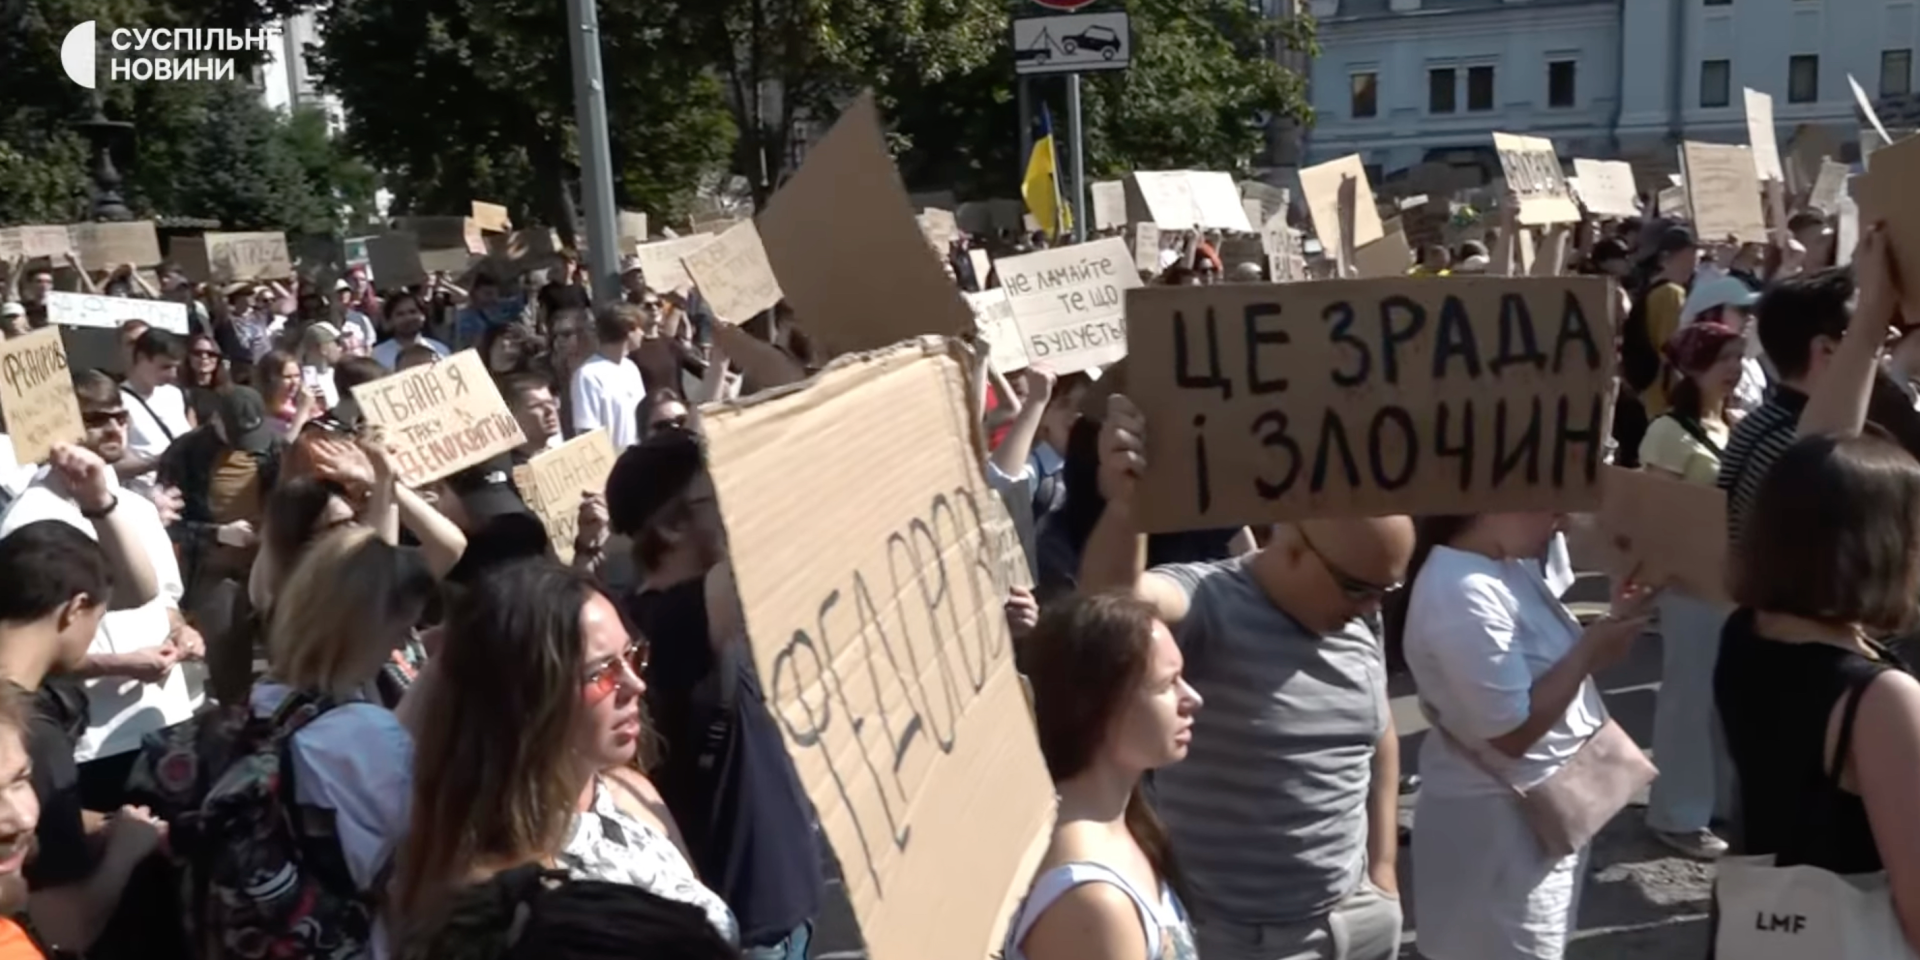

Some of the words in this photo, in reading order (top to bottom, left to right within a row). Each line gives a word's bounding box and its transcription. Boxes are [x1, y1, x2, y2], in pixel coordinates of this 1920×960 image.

[1172, 303, 1292, 399] ЦЕ
[1321, 290, 1601, 388] ЗРАДА
[446, 363, 469, 397] Я
[1250, 394, 1600, 500] ЗЛОЧИН
[1755, 911, 1807, 934] LMF
